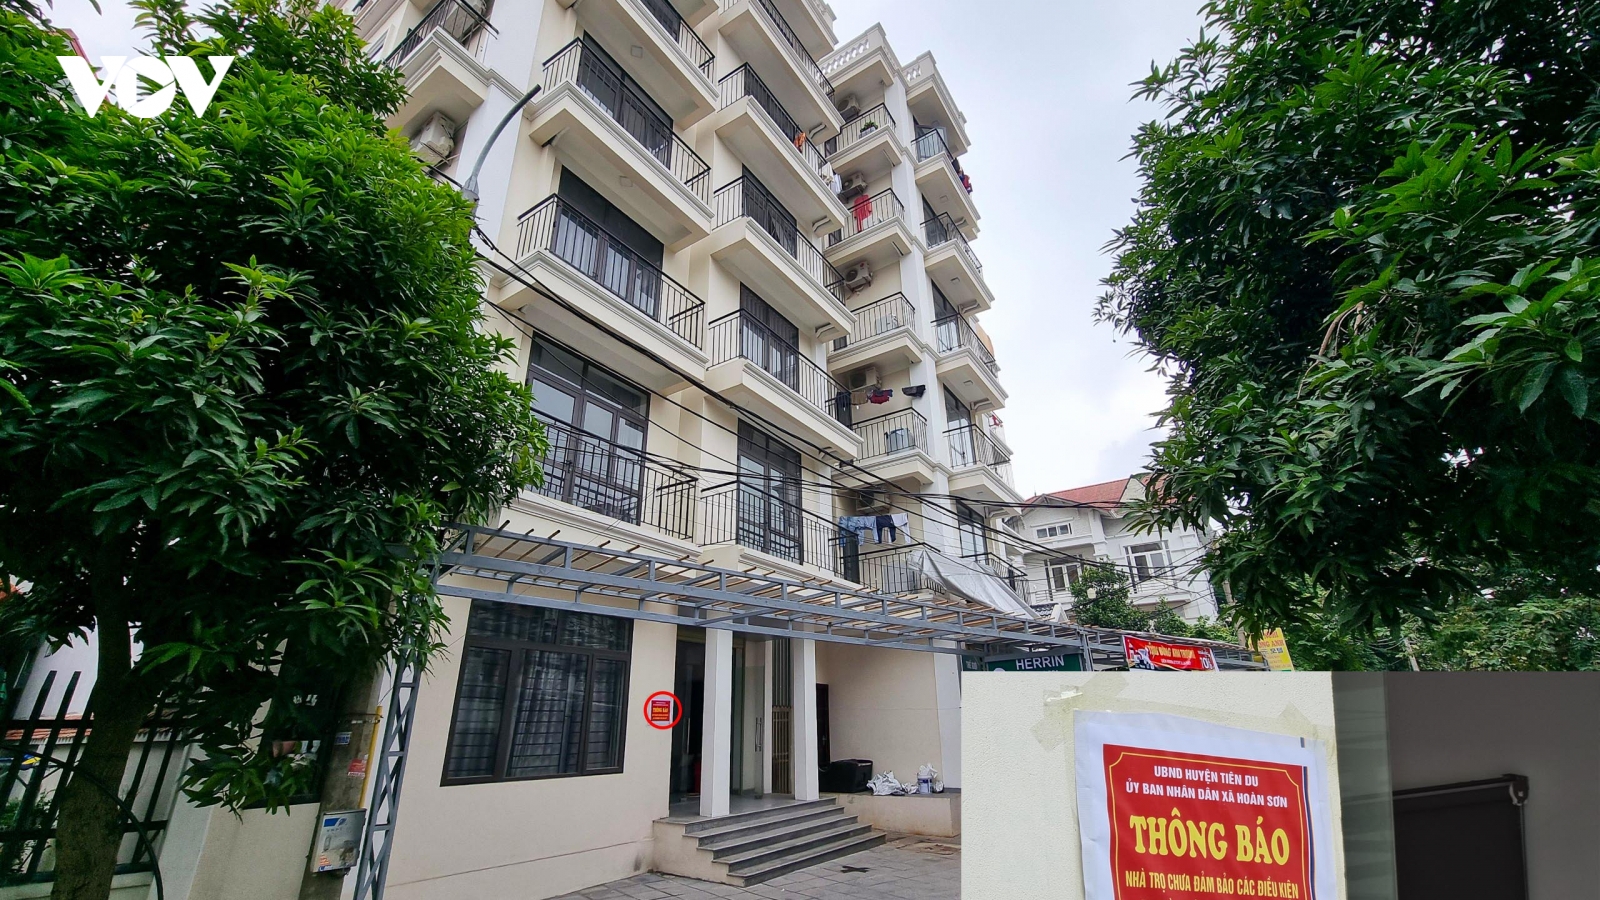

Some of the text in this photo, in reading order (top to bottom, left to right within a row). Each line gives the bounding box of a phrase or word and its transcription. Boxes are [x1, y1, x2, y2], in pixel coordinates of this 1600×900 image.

[1016, 655, 1064, 670] HERRIN
[1154, 765, 1258, 787] UBND HUYỆN TIÊN DU
[1126, 778, 1288, 808] ỦY BAN NHÂN DÂN XÃ HOÀN SƠN
[1130, 807, 1290, 866] THÔNG BÁO
[1125, 868, 1146, 888] NHÀ
[1149, 872, 1166, 893] TRỌ
[1167, 874, 1191, 891] CHƯA
[1193, 871, 1215, 893] ĐẢM
[1216, 872, 1234, 894] BẢO
[1237, 876, 1255, 896] CÁC
[1257, 876, 1278, 897] ĐIỀU
